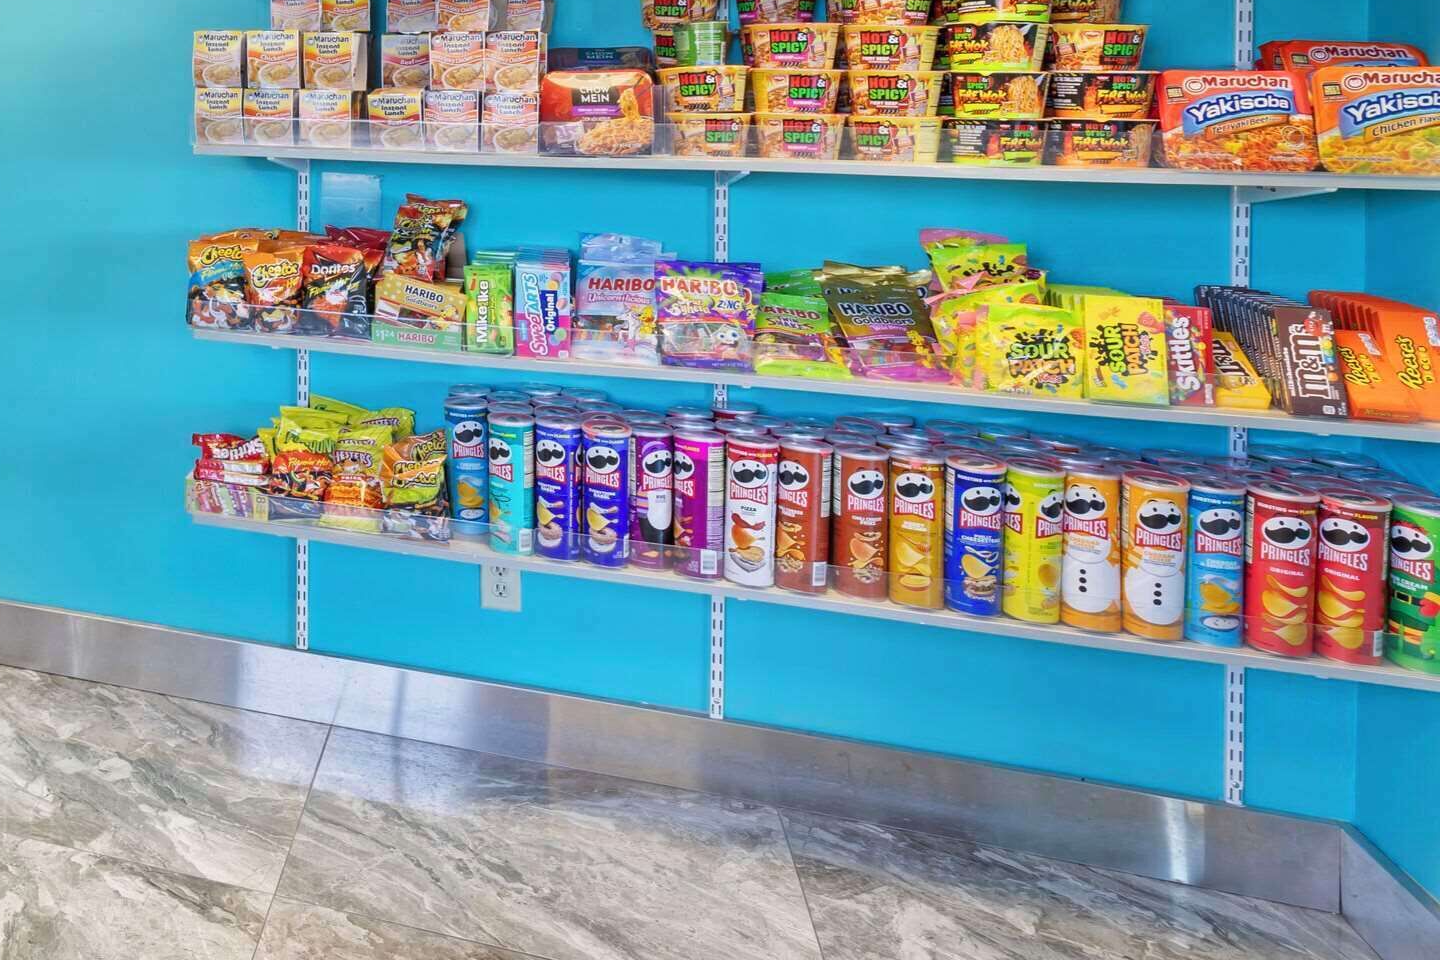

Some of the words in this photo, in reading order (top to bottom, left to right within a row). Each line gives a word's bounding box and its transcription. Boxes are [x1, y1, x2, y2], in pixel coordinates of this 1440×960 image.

[1324, 46, 1409, 59] Maruchan
[1202, 76, 1289, 89] Maruchan
[1363, 72, 1440, 85] Marucha
[581, 94, 610, 103] MEIN
[1348, 91, 1440, 125] Yakisob
[1188, 94, 1292, 125] Yakisoba
[1372, 118, 1417, 137] Chicken
[200, 245, 243, 265] Cheeto
[250, 262, 300, 288] Cheetos
[311, 262, 359, 276] Doritos
[404, 284, 445, 303] HARIBO
[588, 278, 656, 291] HARIBO
[660, 276, 738, 296] HARIBO
[546, 292, 556, 333] Original
[839, 302, 912, 316] HARIBO
[853, 316, 915, 326] Goldbears
[397, 332, 435, 344] HARIBO
[1009, 341, 1070, 360] SOUR
[1103, 324, 1127, 373] SOUR
[1121, 323, 1149, 375] PATCH
[1172, 316, 1201, 391] Skittles
[1009, 357, 1076, 377] PATCH
[453, 443, 484, 458] PRINGLES
[585, 468, 619, 488] PRINGLES
[730, 482, 768, 504] PRINGLES
[847, 494, 885, 513] PRINGLES
[894, 498, 935, 520] PRINGLES
[960, 510, 1001, 530] PRINGLES
[1063, 516, 1108, 538] PRINGLES
[1136, 530, 1182, 550] PRINGLES
[1196, 533, 1242, 555] PRINGLES
[1260, 543, 1310, 567] PRINGLES
[1318, 543, 1369, 572] PRINGLES
[1269, 567, 1305, 577] ORIGINAL
[1324, 567, 1361, 581] ORIGINAL
